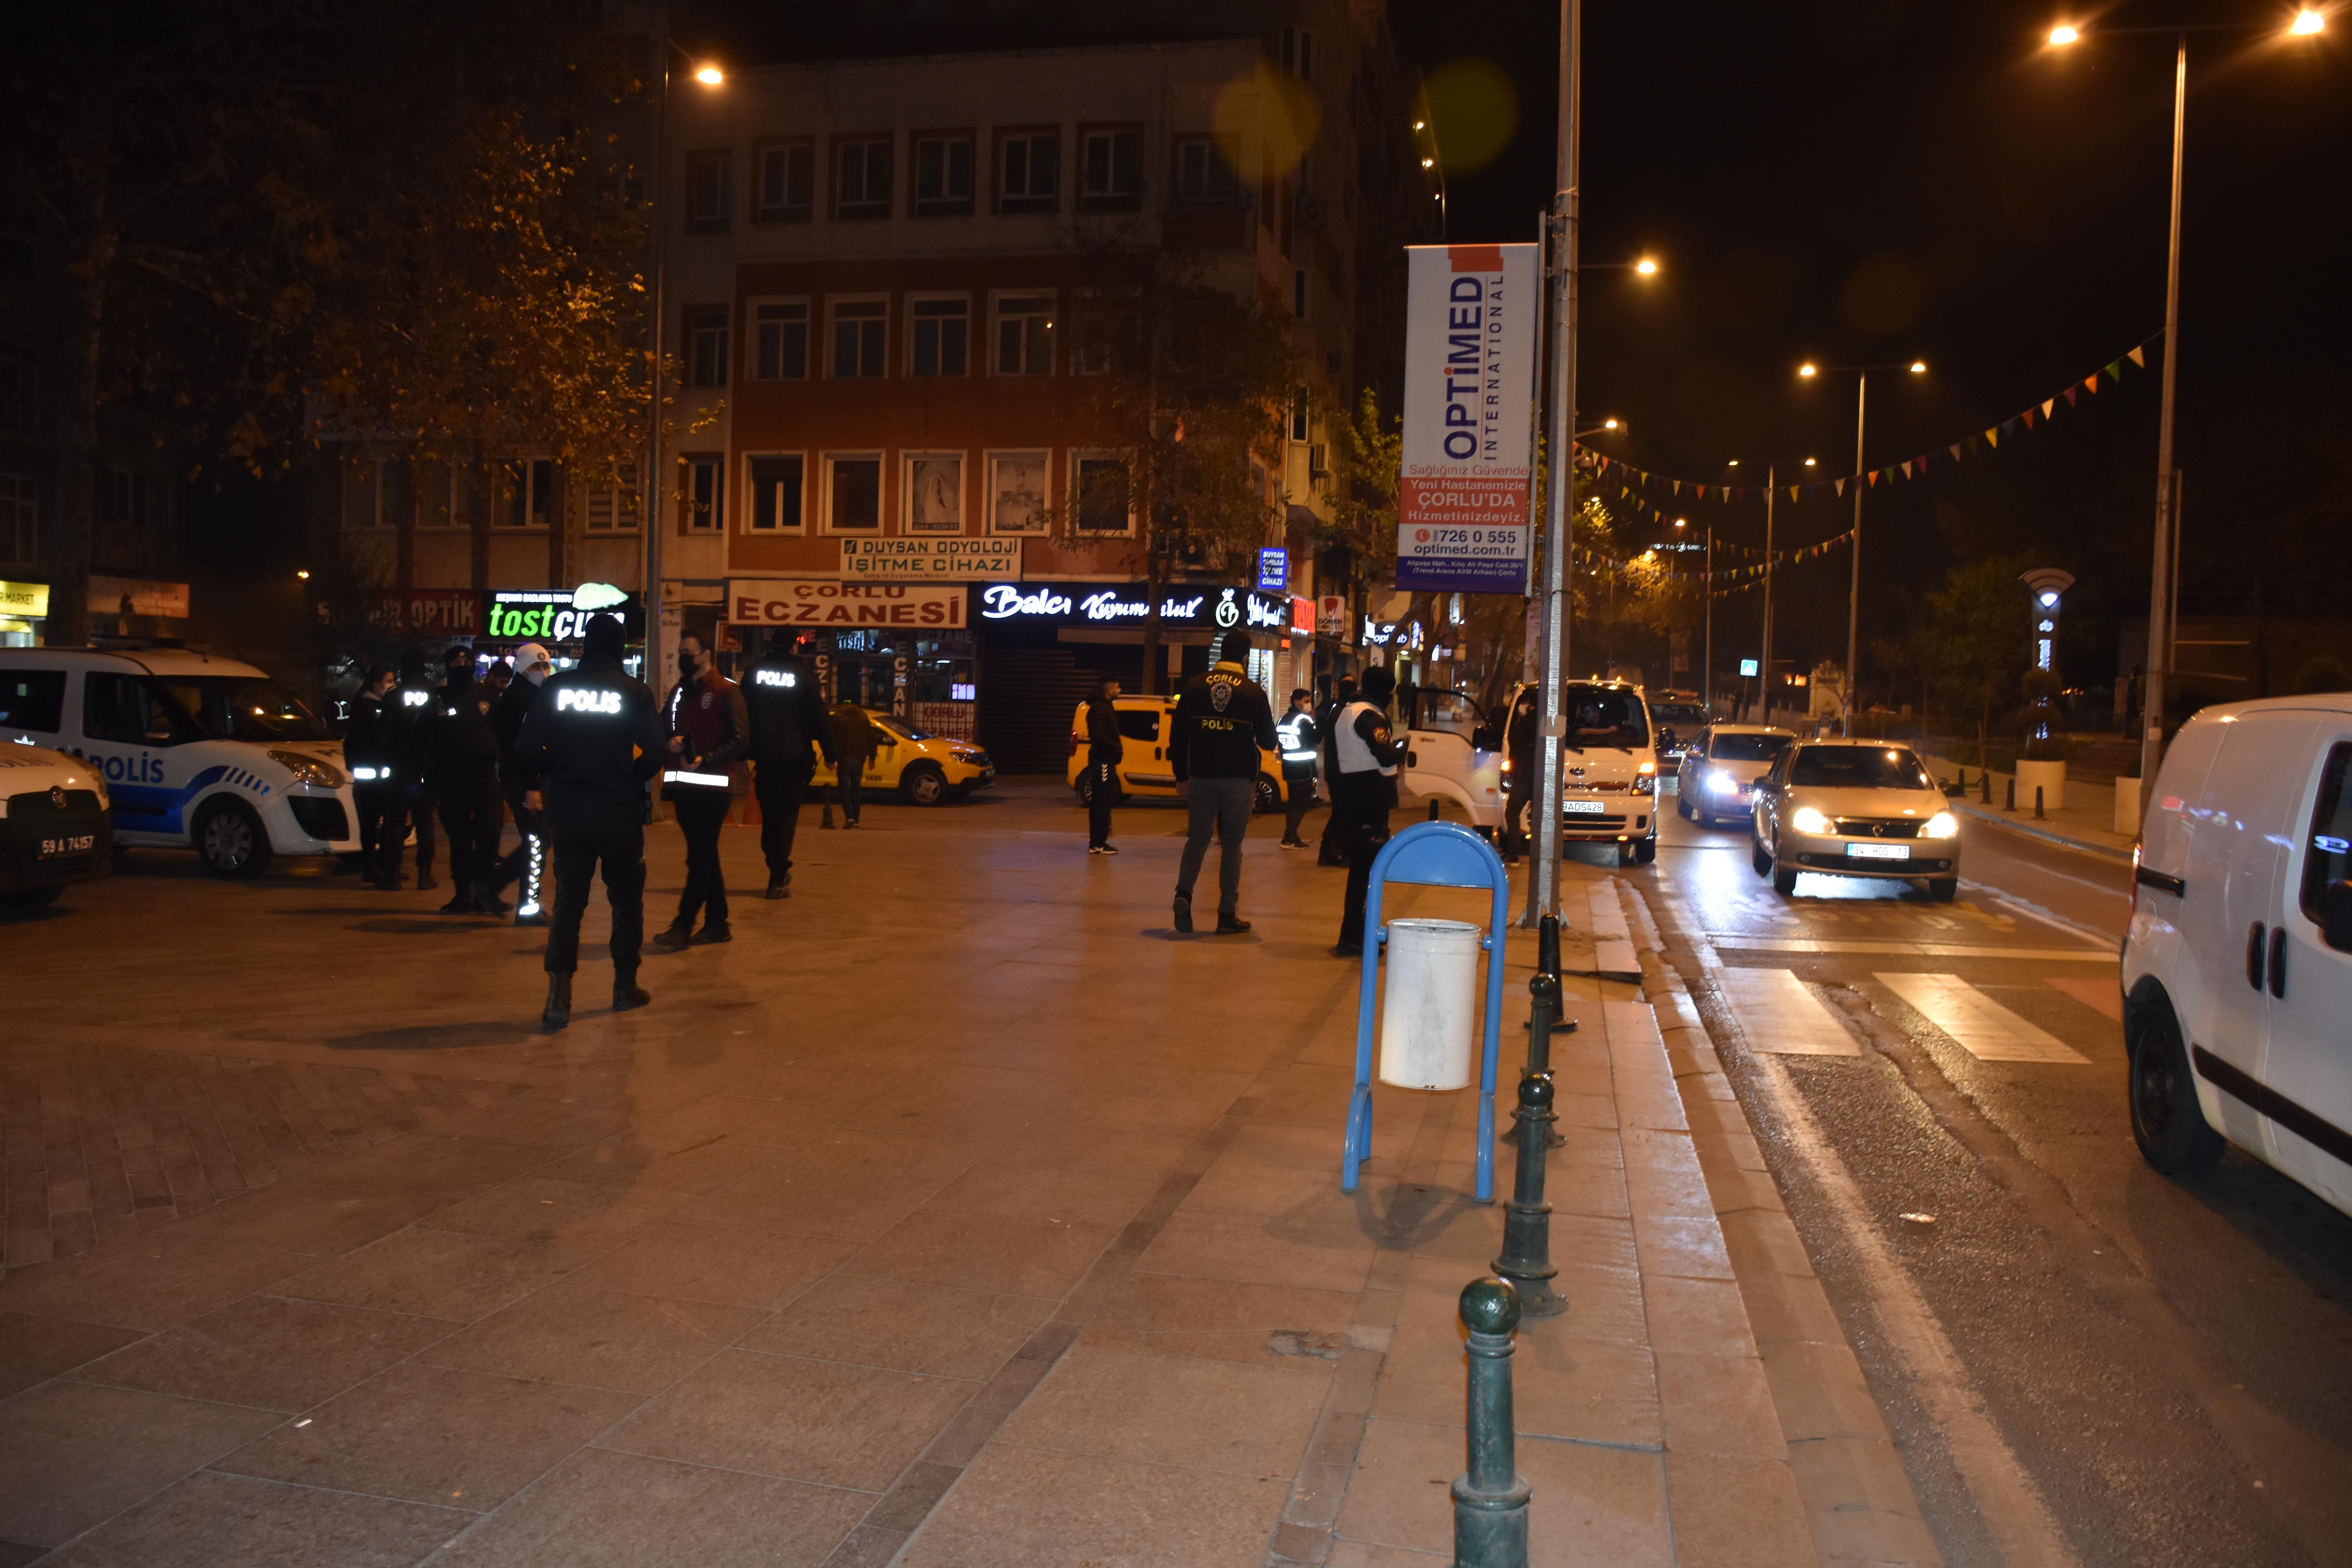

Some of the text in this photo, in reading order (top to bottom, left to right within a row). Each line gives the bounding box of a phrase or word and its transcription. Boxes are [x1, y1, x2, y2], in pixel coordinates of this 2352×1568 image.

[1484, 276, 1504, 461] INTERNATIONAL
[1409, 464, 1528, 477] Sağlığınız Güvende
[1411, 479, 1526, 490] Yeni Hastanemizle
[1417, 492, 1516, 510] ÇORLU'DA
[1408, 510, 1524, 524] Hizmetinizdeyiz.
[1440, 530, 1516, 543] 726 0 555
[864, 539, 1017, 554] DUYSAN ODYOLOJİ
[1414, 544, 1516, 556] optimed.com.tr
[848, 556, 1010, 573] İŞİTME CİHAZI
[1262, 577, 1283, 586] CİHAZI
[5, 592, 34, 605] MARKET
[793, 585, 906, 599] ÇORLU
[982, 585, 1072, 619] Balcı
[411, 594, 474, 628] OPTİK
[737, 596, 960, 624] ECZANESİ
[1206, 674, 1242, 686] ÇORLU
[1201, 718, 1234, 731] POLİS
[42, 839, 56, 853] 59
[58, 839, 65, 852] A
[1855, 846, 1907, 857] 34 HDG 13
